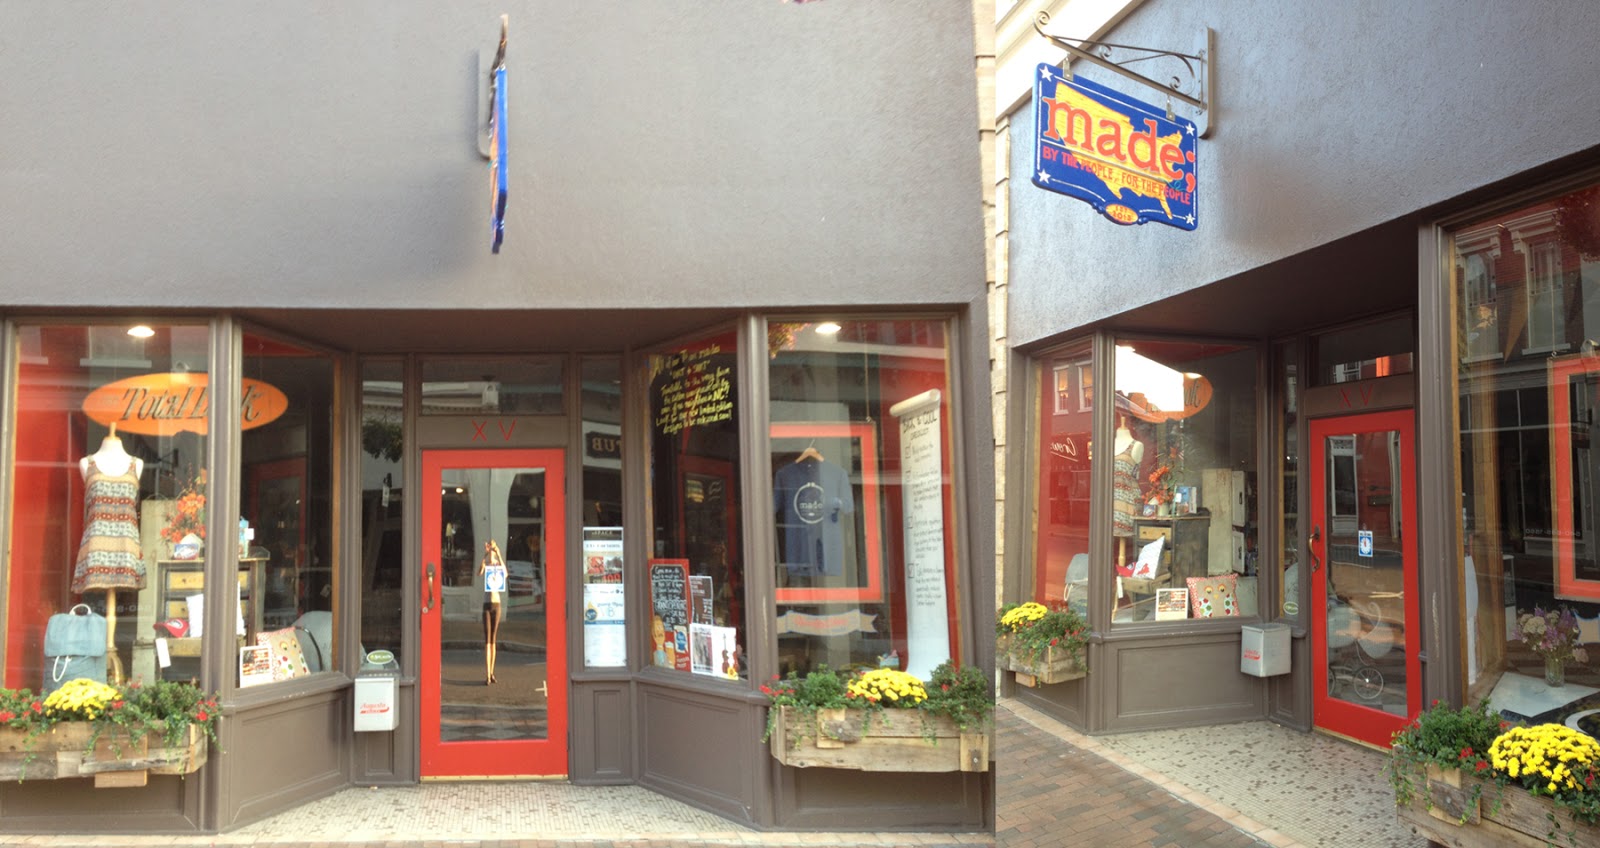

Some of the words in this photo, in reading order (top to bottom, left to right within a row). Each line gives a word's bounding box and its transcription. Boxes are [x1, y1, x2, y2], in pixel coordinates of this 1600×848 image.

[1042, 145, 1059, 162] BY
[1061, 151, 1079, 169] THE
[1121, 171, 1138, 188] FOR
[1141, 177, 1158, 195] THE
[1158, 181, 1191, 205] PEOPLE
[119, 386, 195, 421] Total
